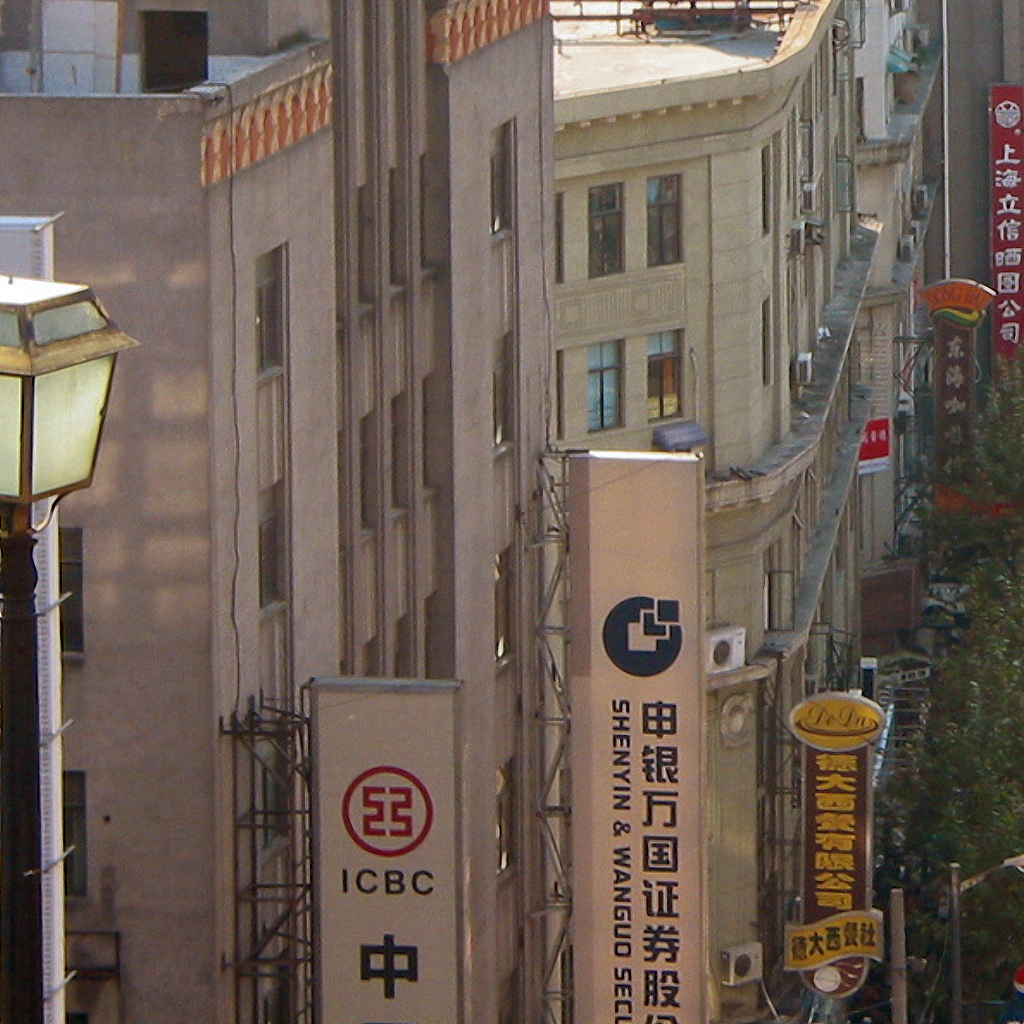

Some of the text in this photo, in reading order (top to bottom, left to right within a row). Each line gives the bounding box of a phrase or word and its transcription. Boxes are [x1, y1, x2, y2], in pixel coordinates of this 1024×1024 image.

[612, 698, 631, 811] SHENYIN
[613, 820, 632, 838] &
[341, 869, 434, 896] ICBC
[613, 846, 633, 958] WANGUO
